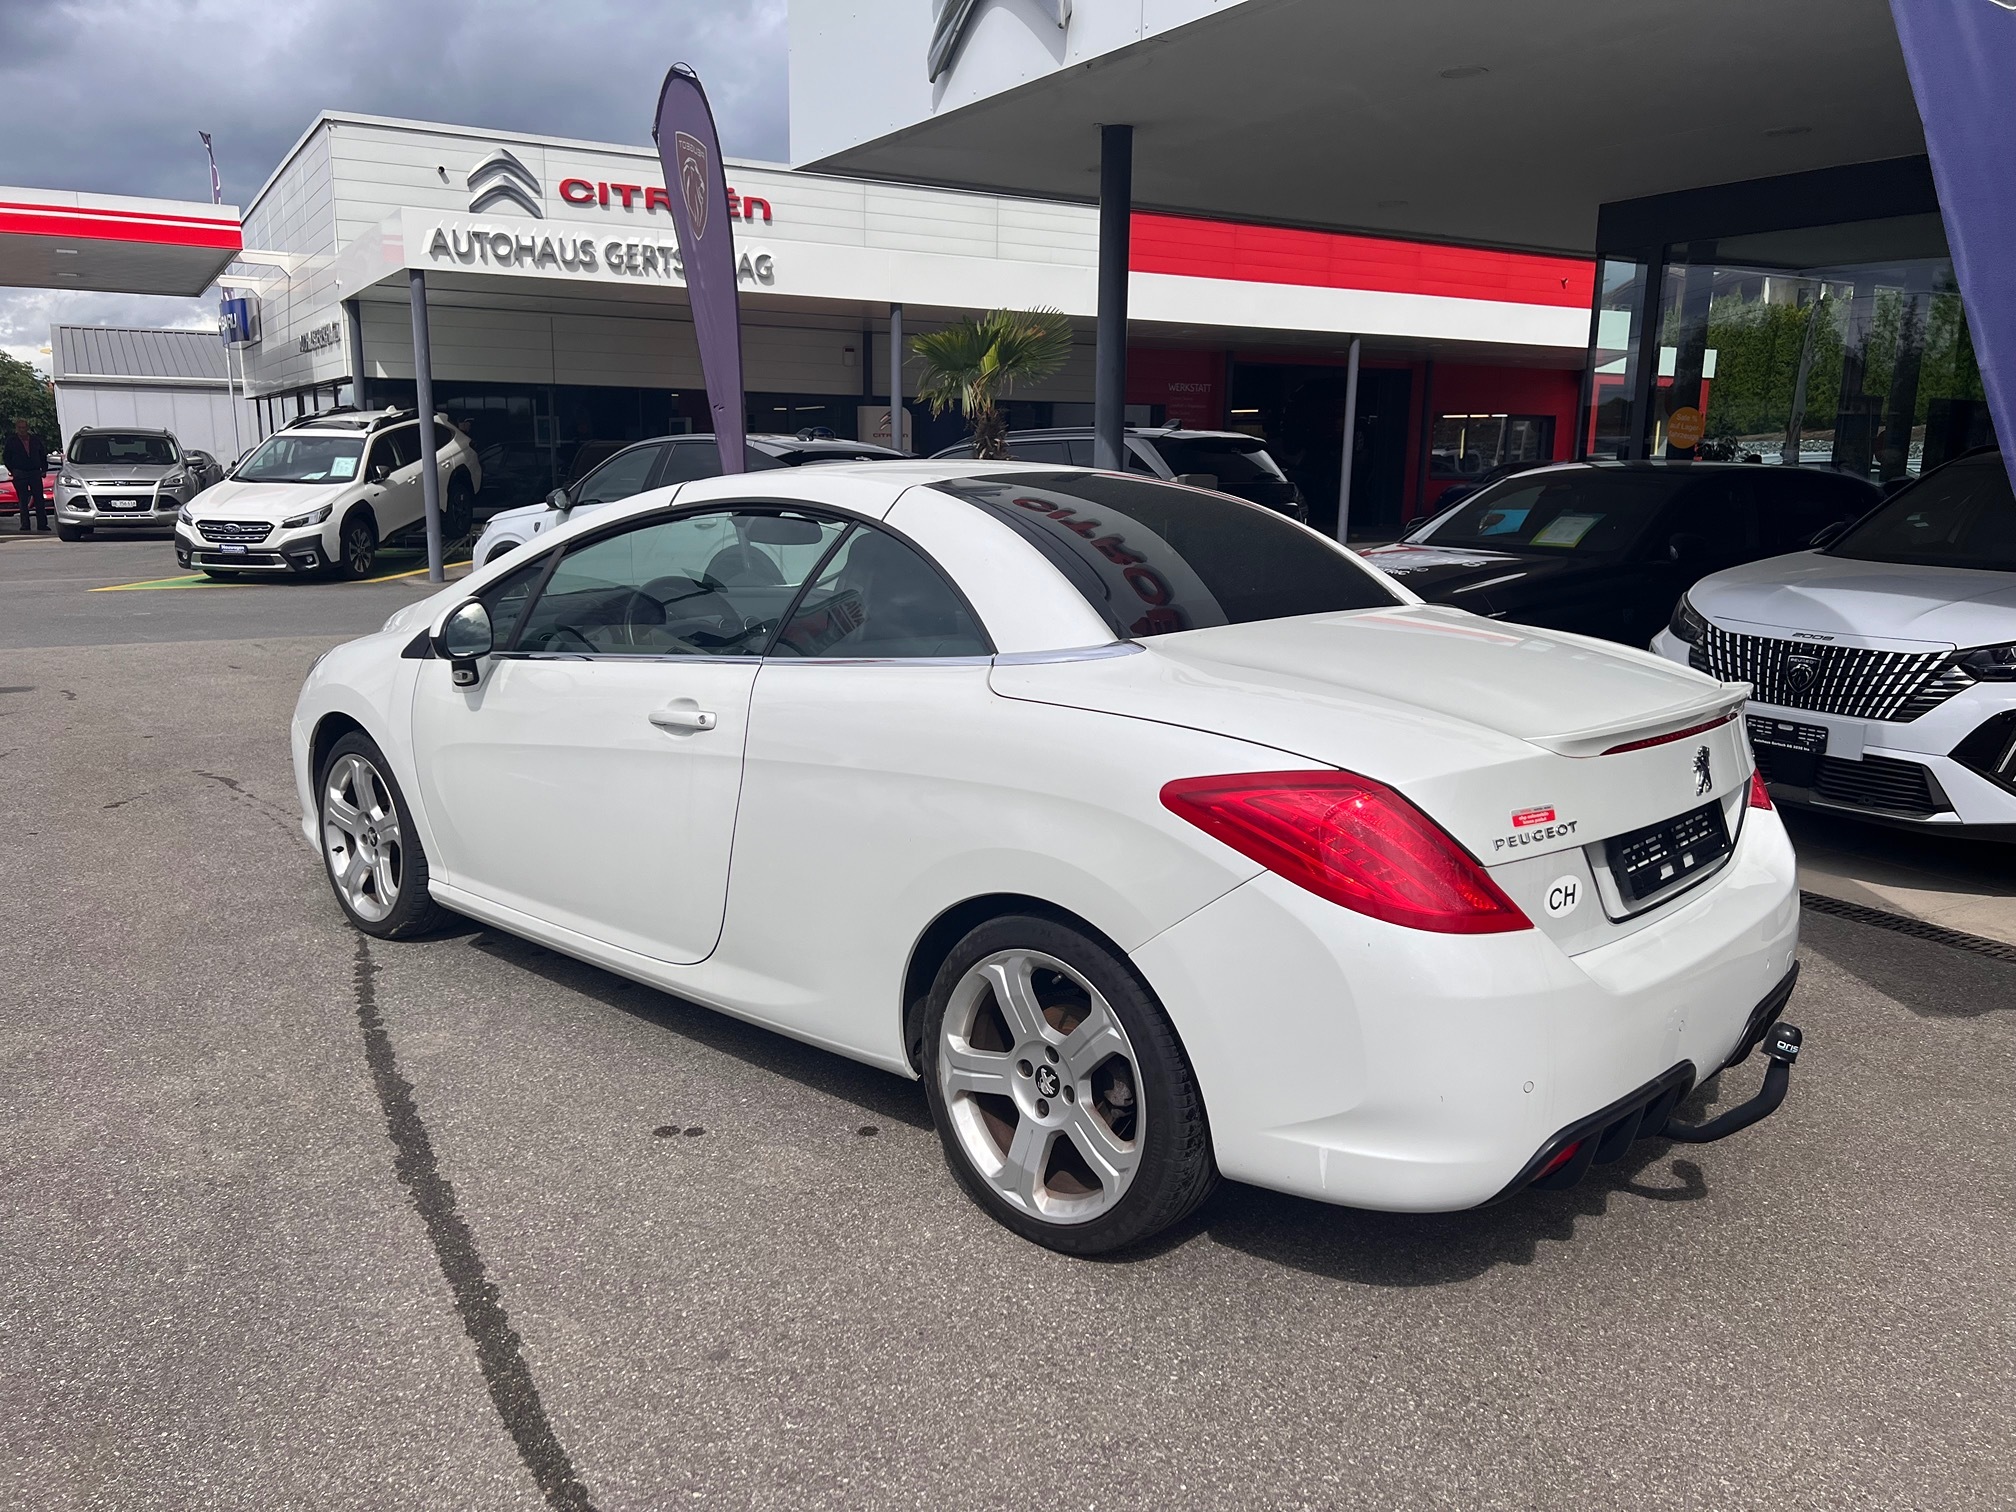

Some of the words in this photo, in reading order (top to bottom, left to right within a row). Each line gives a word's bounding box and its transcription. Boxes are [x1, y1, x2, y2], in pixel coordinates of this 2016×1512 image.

[429, 227, 597, 266] AUTOHAUS
[605, 241, 683, 273] GERTS
[737, 252, 774, 281] AG
[1168, 382, 1212, 393] WERKSTATT
[1676, 413, 1690, 422] Sale
[1792, 632, 1835, 642] 2008
[1493, 820, 1577, 851] PEUGEOT
[1549, 883, 1576, 911] CH
